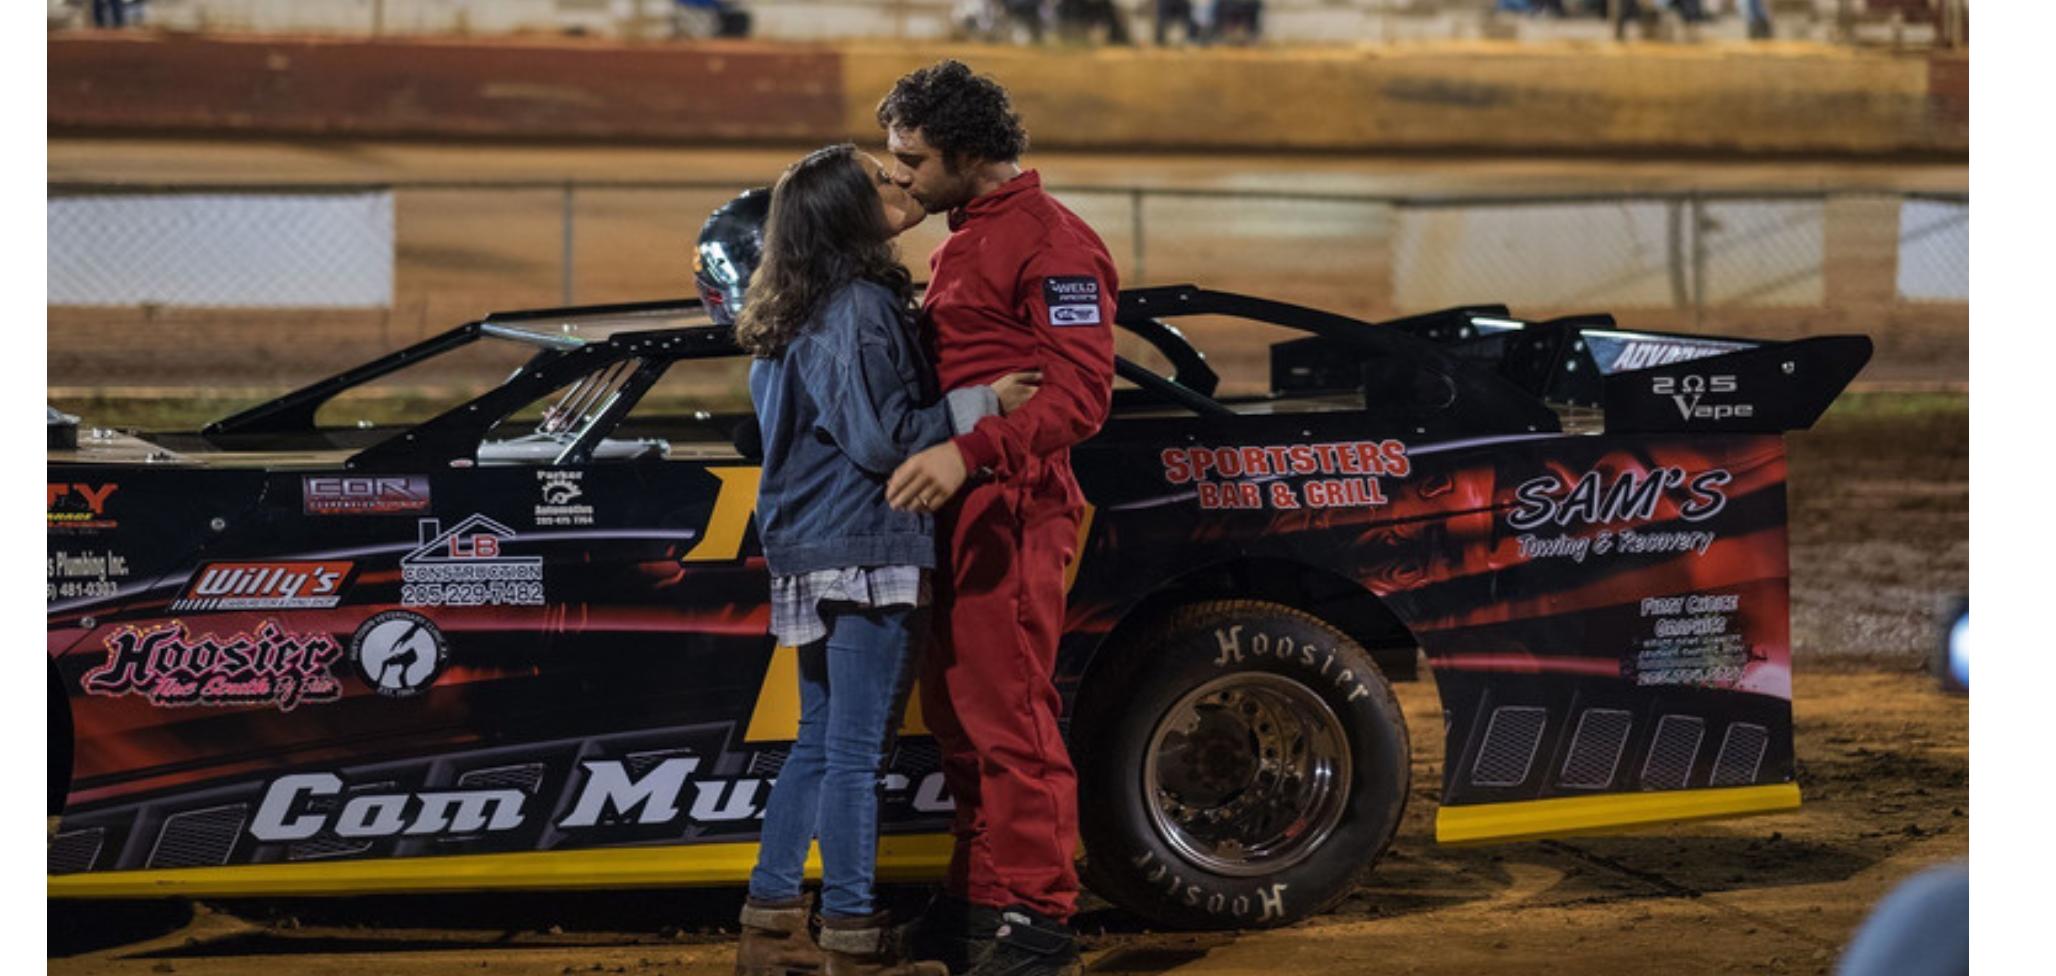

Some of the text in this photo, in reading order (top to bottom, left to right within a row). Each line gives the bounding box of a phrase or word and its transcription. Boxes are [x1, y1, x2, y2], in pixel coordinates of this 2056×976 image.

[1672, 394, 1753, 421] Vape
[1160, 439, 1411, 484] SPORTSTERS
[1199, 476, 1388, 509] BAR & GRILL
[1508, 467, 1732, 529] SAM'S
[448, 534, 500, 558] LB
[56, 551, 107, 582] Plumbing
[108, 550, 129, 576] Inc.
[401, 564, 544, 582] CONSTRUCTION
[196, 566, 340, 600] Willy's
[401, 581, 546, 606] 205-229-7482
[83, 620, 342, 695] Hoosier
[1214, 625, 1368, 701] Hoosier
[250, 772, 526, 841] Cam
